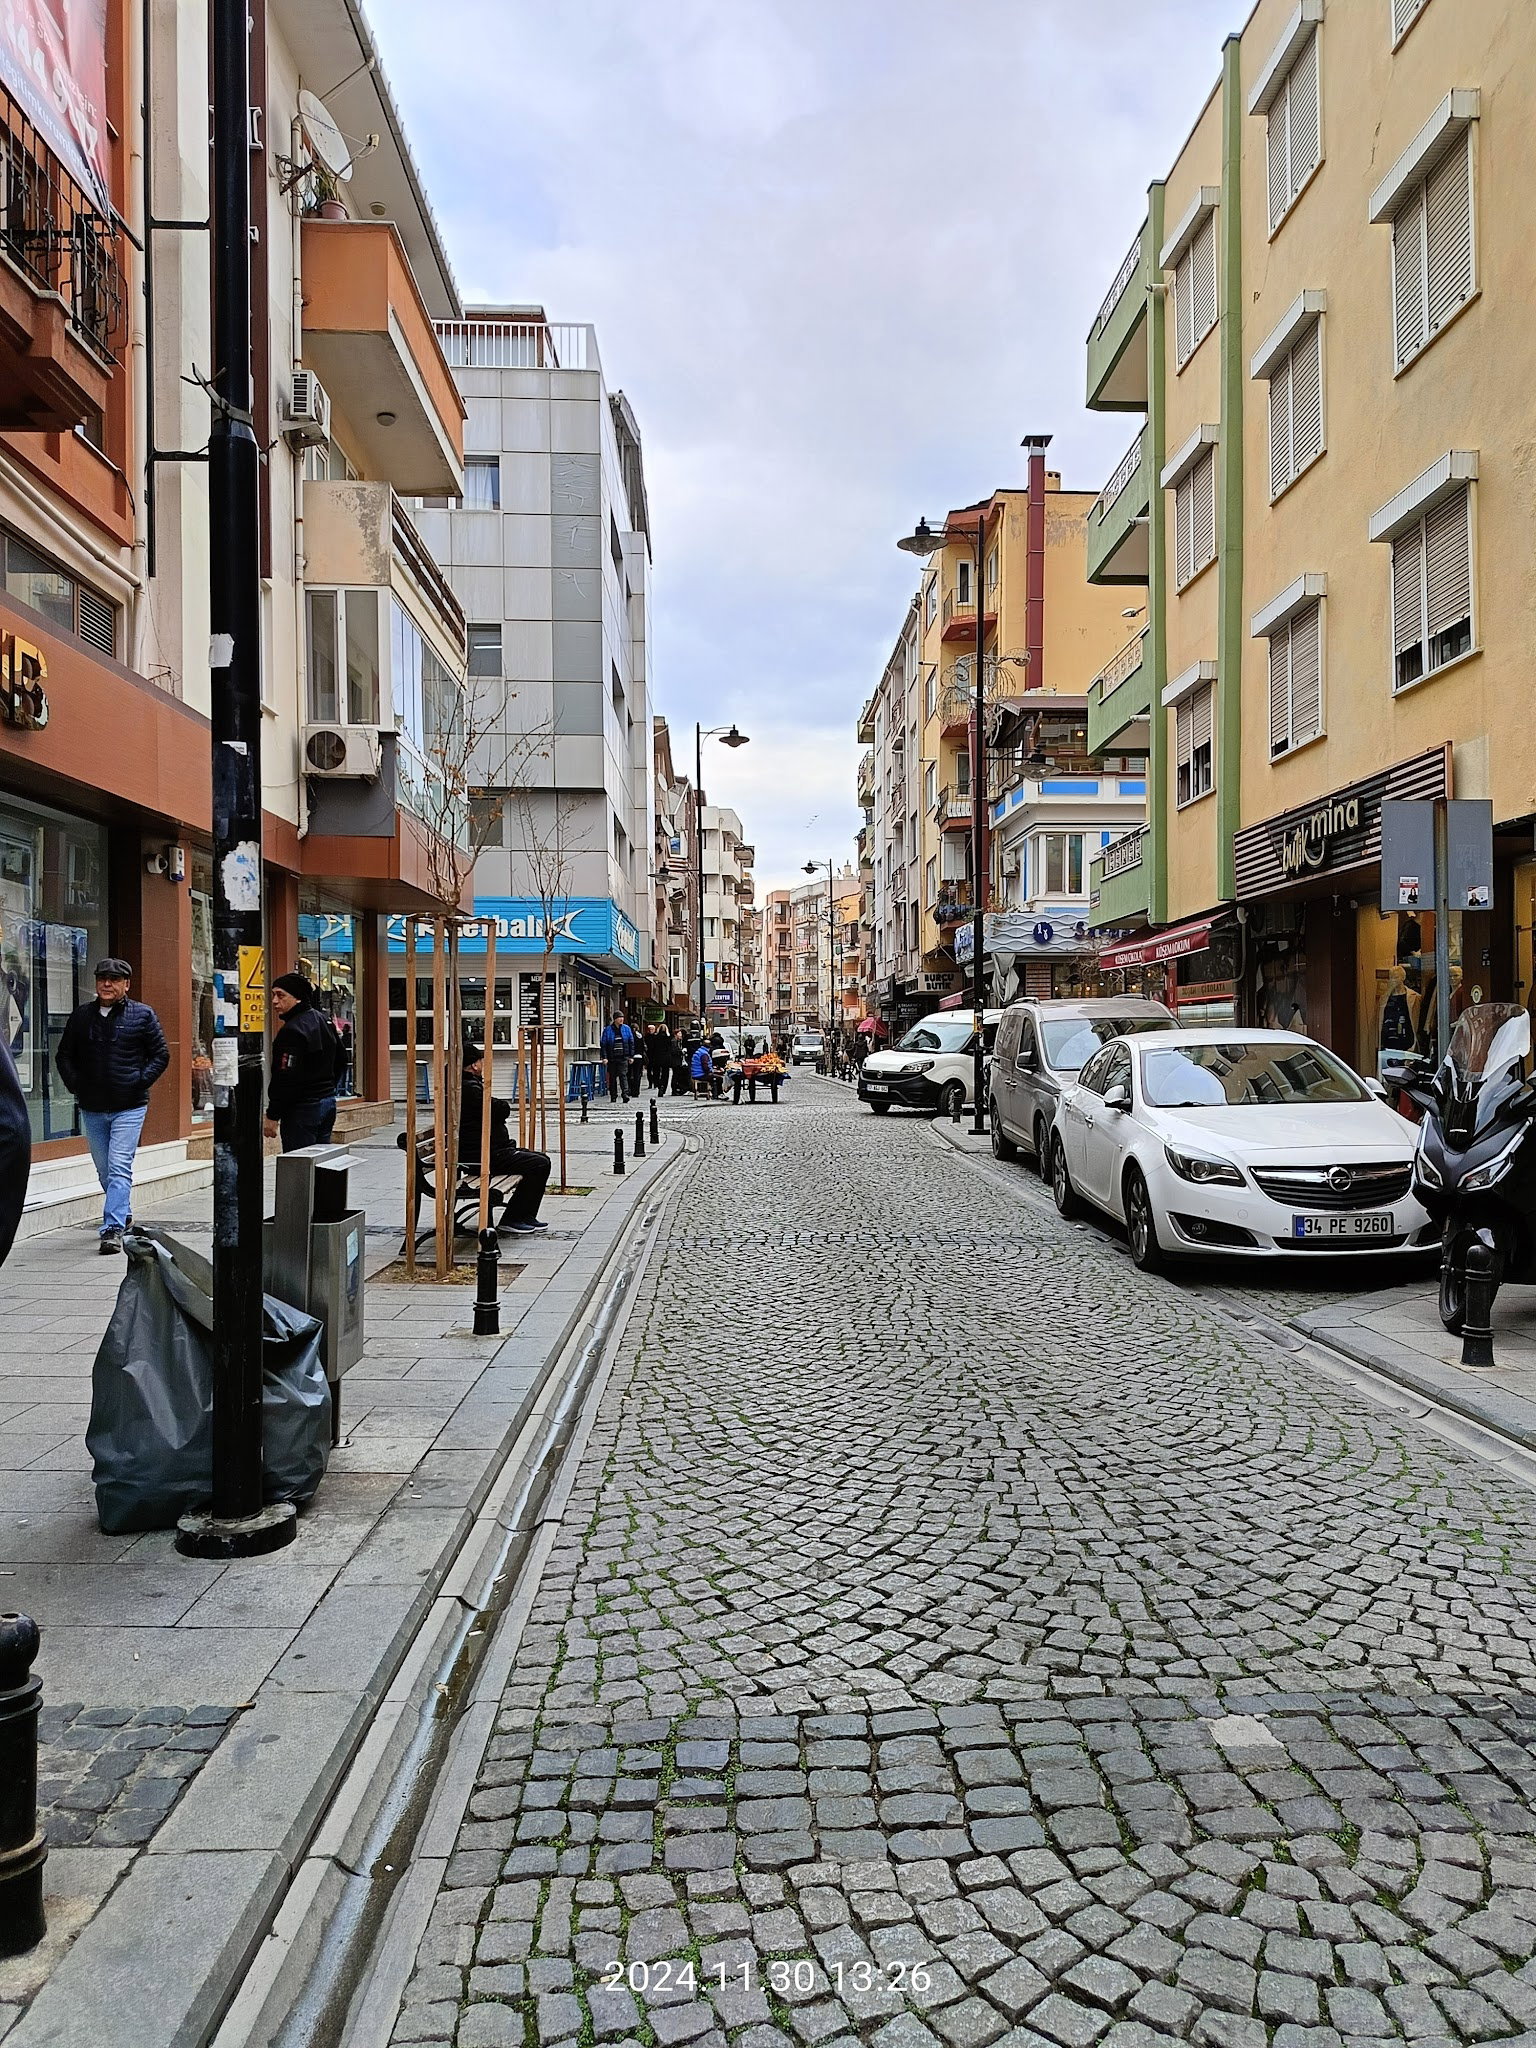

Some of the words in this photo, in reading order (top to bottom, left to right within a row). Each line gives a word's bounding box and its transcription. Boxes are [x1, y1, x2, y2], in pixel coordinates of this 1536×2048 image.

[1311, 797, 1359, 840] mina
[1282, 823, 1324, 874] butik
[1304, 1218, 1322, 1234] 34
[1329, 1218, 1347, 1233] PE
[1354, 1217, 1388, 1233] 9260
